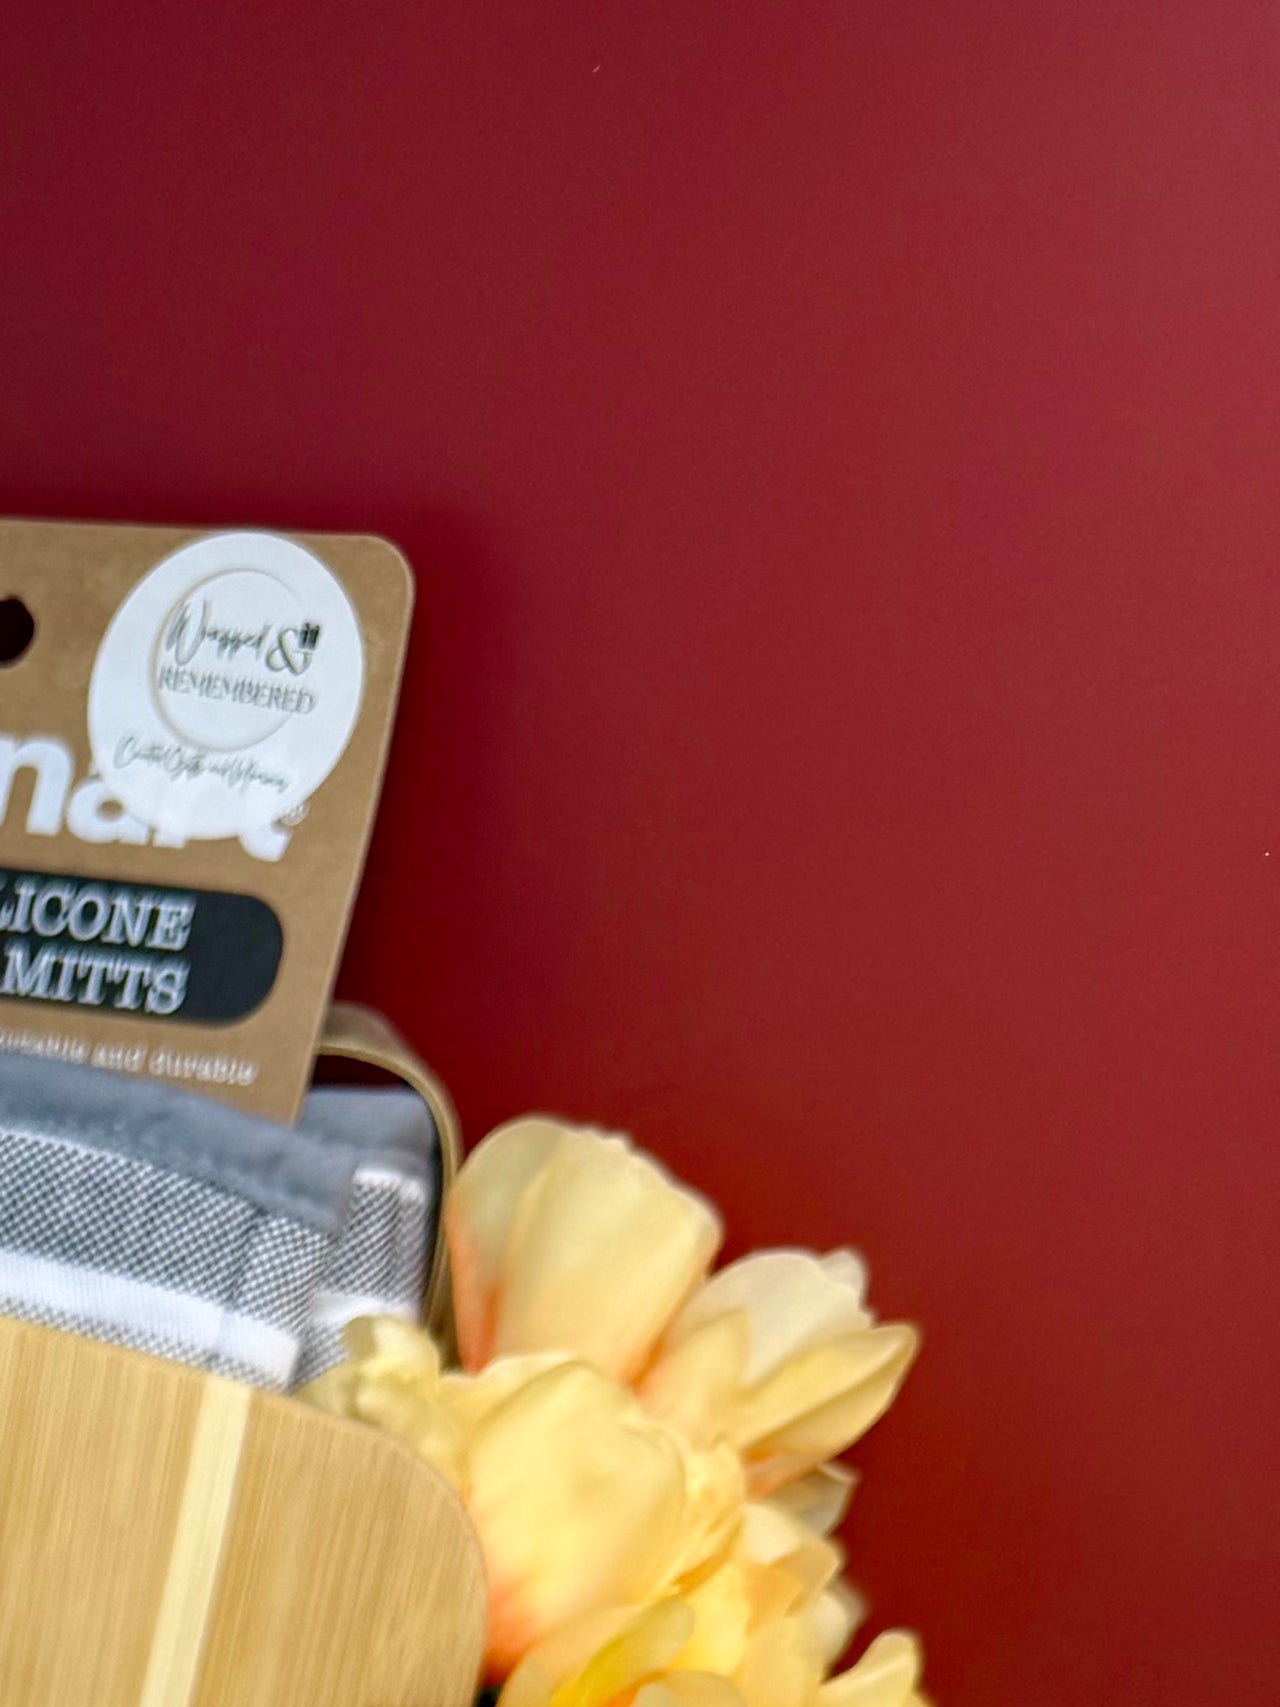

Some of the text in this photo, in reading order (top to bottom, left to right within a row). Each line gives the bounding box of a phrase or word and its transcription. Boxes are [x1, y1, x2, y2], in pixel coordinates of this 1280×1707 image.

[266, 627, 313, 676] &
[158, 665, 318, 715] REMEMBERED
[148, 1046, 260, 1087] durable
